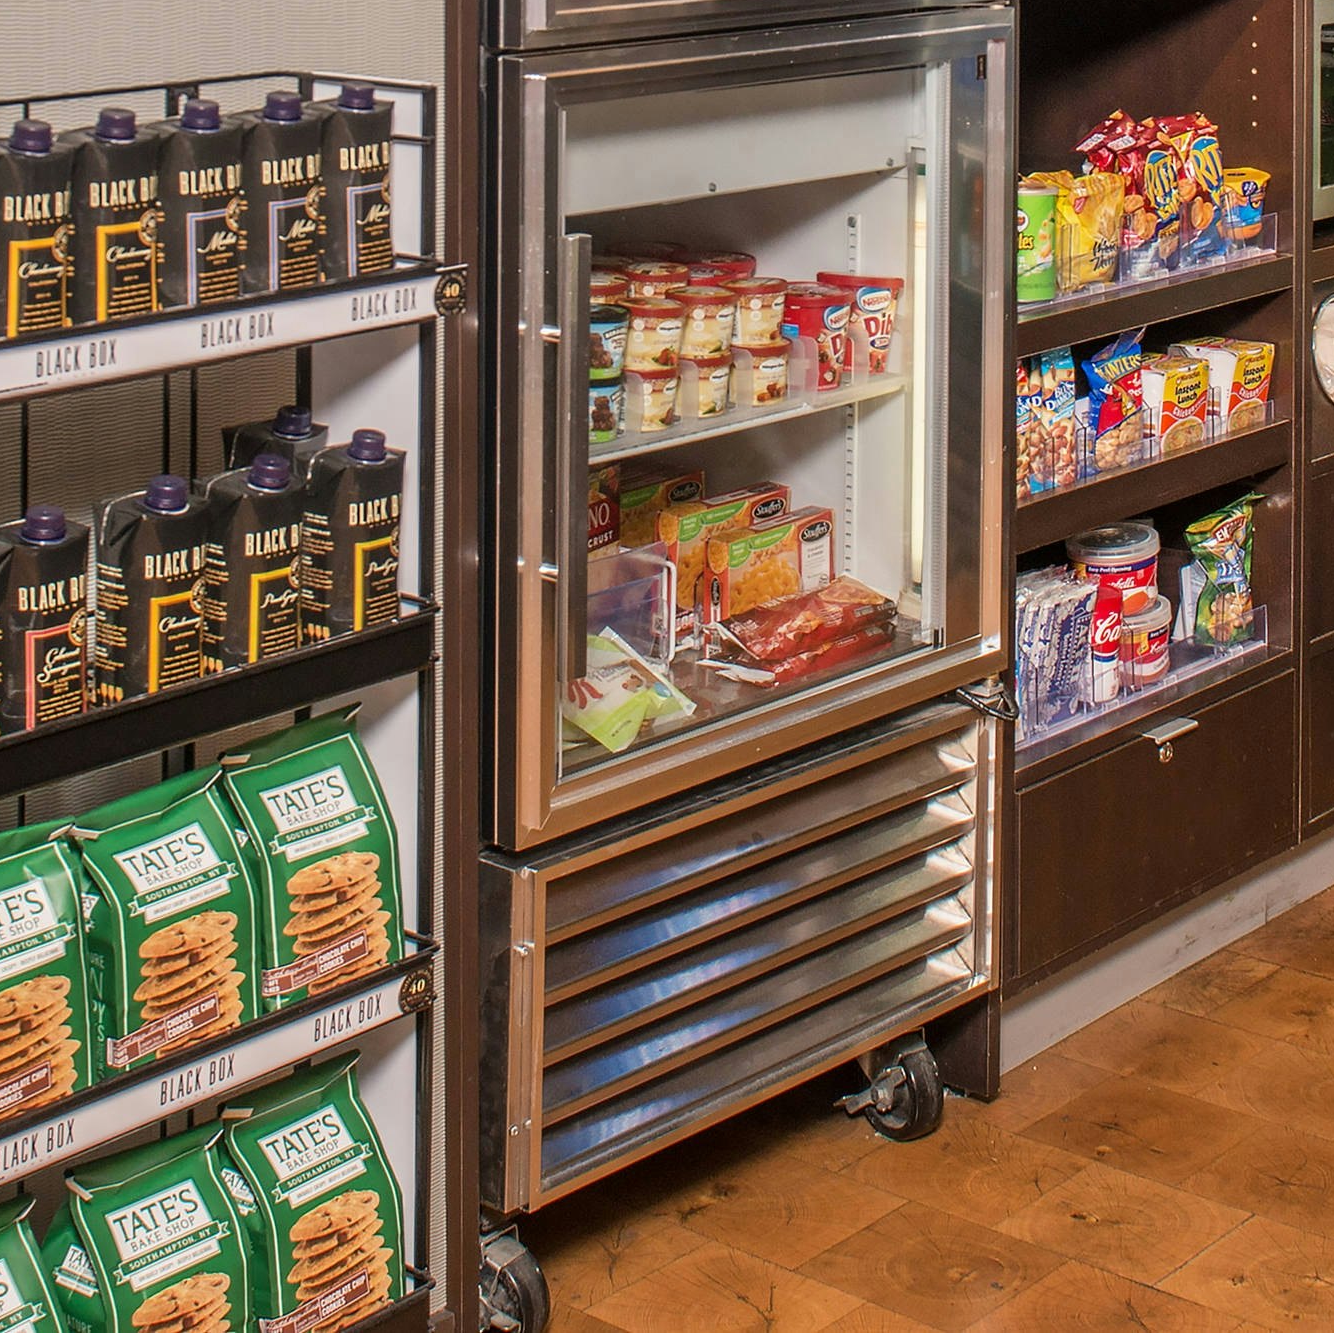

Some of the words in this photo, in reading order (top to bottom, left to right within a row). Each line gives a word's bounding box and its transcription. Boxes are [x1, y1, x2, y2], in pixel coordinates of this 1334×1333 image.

[178, 168, 223, 195] BLACK
[261, 157, 303, 185] BLACK
[89, 178, 136, 208] BLACK
[3, 193, 51, 222] BLACK
[350, 293, 389, 321] BLACK
[393, 287, 417, 313] BOX
[200, 318, 242, 349] BLACK
[247, 312, 274, 339] BOX
[35, 343, 81, 379] BLACK
[89, 337, 117, 366] BOX
[1243, 364, 1267, 379] Instant
[1174, 380, 1202, 397] Instant
[1243, 375, 1263, 387] Lunch
[1177, 392, 1198, 406] Lunch
[144, 551, 188, 580] BLACK
[17, 582, 66, 612] BLACK
[267, 774, 345, 818] TATE'S
[285, 810, 312, 827] BAKE
[313, 800, 341, 819] SHOP
[344, 812, 357, 823] NY
[122, 829, 206, 878] TATE'S
[143, 871, 172, 888] BAKE
[174, 857, 203, 879] SHOP
[10, 916, 41, 937] SHOP
[43, 929, 57, 941] NY
[317, 943, 348, 965] CHOCOLATE
[318, 954, 345, 974] COOKIES
[167, 1006, 201, 1028] CHOCOLATE
[167, 1018, 194, 1039] COOKIES
[313, 1006, 354, 1043] BLACK
[358, 992, 382, 1023] BOX
[159, 1065, 202, 1106] BLACK
[208, 1052, 236, 1086] BOX
[47, 1117, 75, 1151] BOX
[264, 1113, 341, 1165] TATE'S
[286, 1154, 314, 1173] BAKE
[314, 1140, 340, 1162] SHOP
[345, 1148, 356, 1160] NY
[113, 1188, 199, 1243] TATE'S
[130, 1232, 161, 1253] BAKE
[163, 1214, 196, 1240] SHOP
[197, 1226, 212, 1239] NY
[319, 1285, 351, 1306] CHOCOLATE
[320, 1297, 347, 1316] COOKIES
